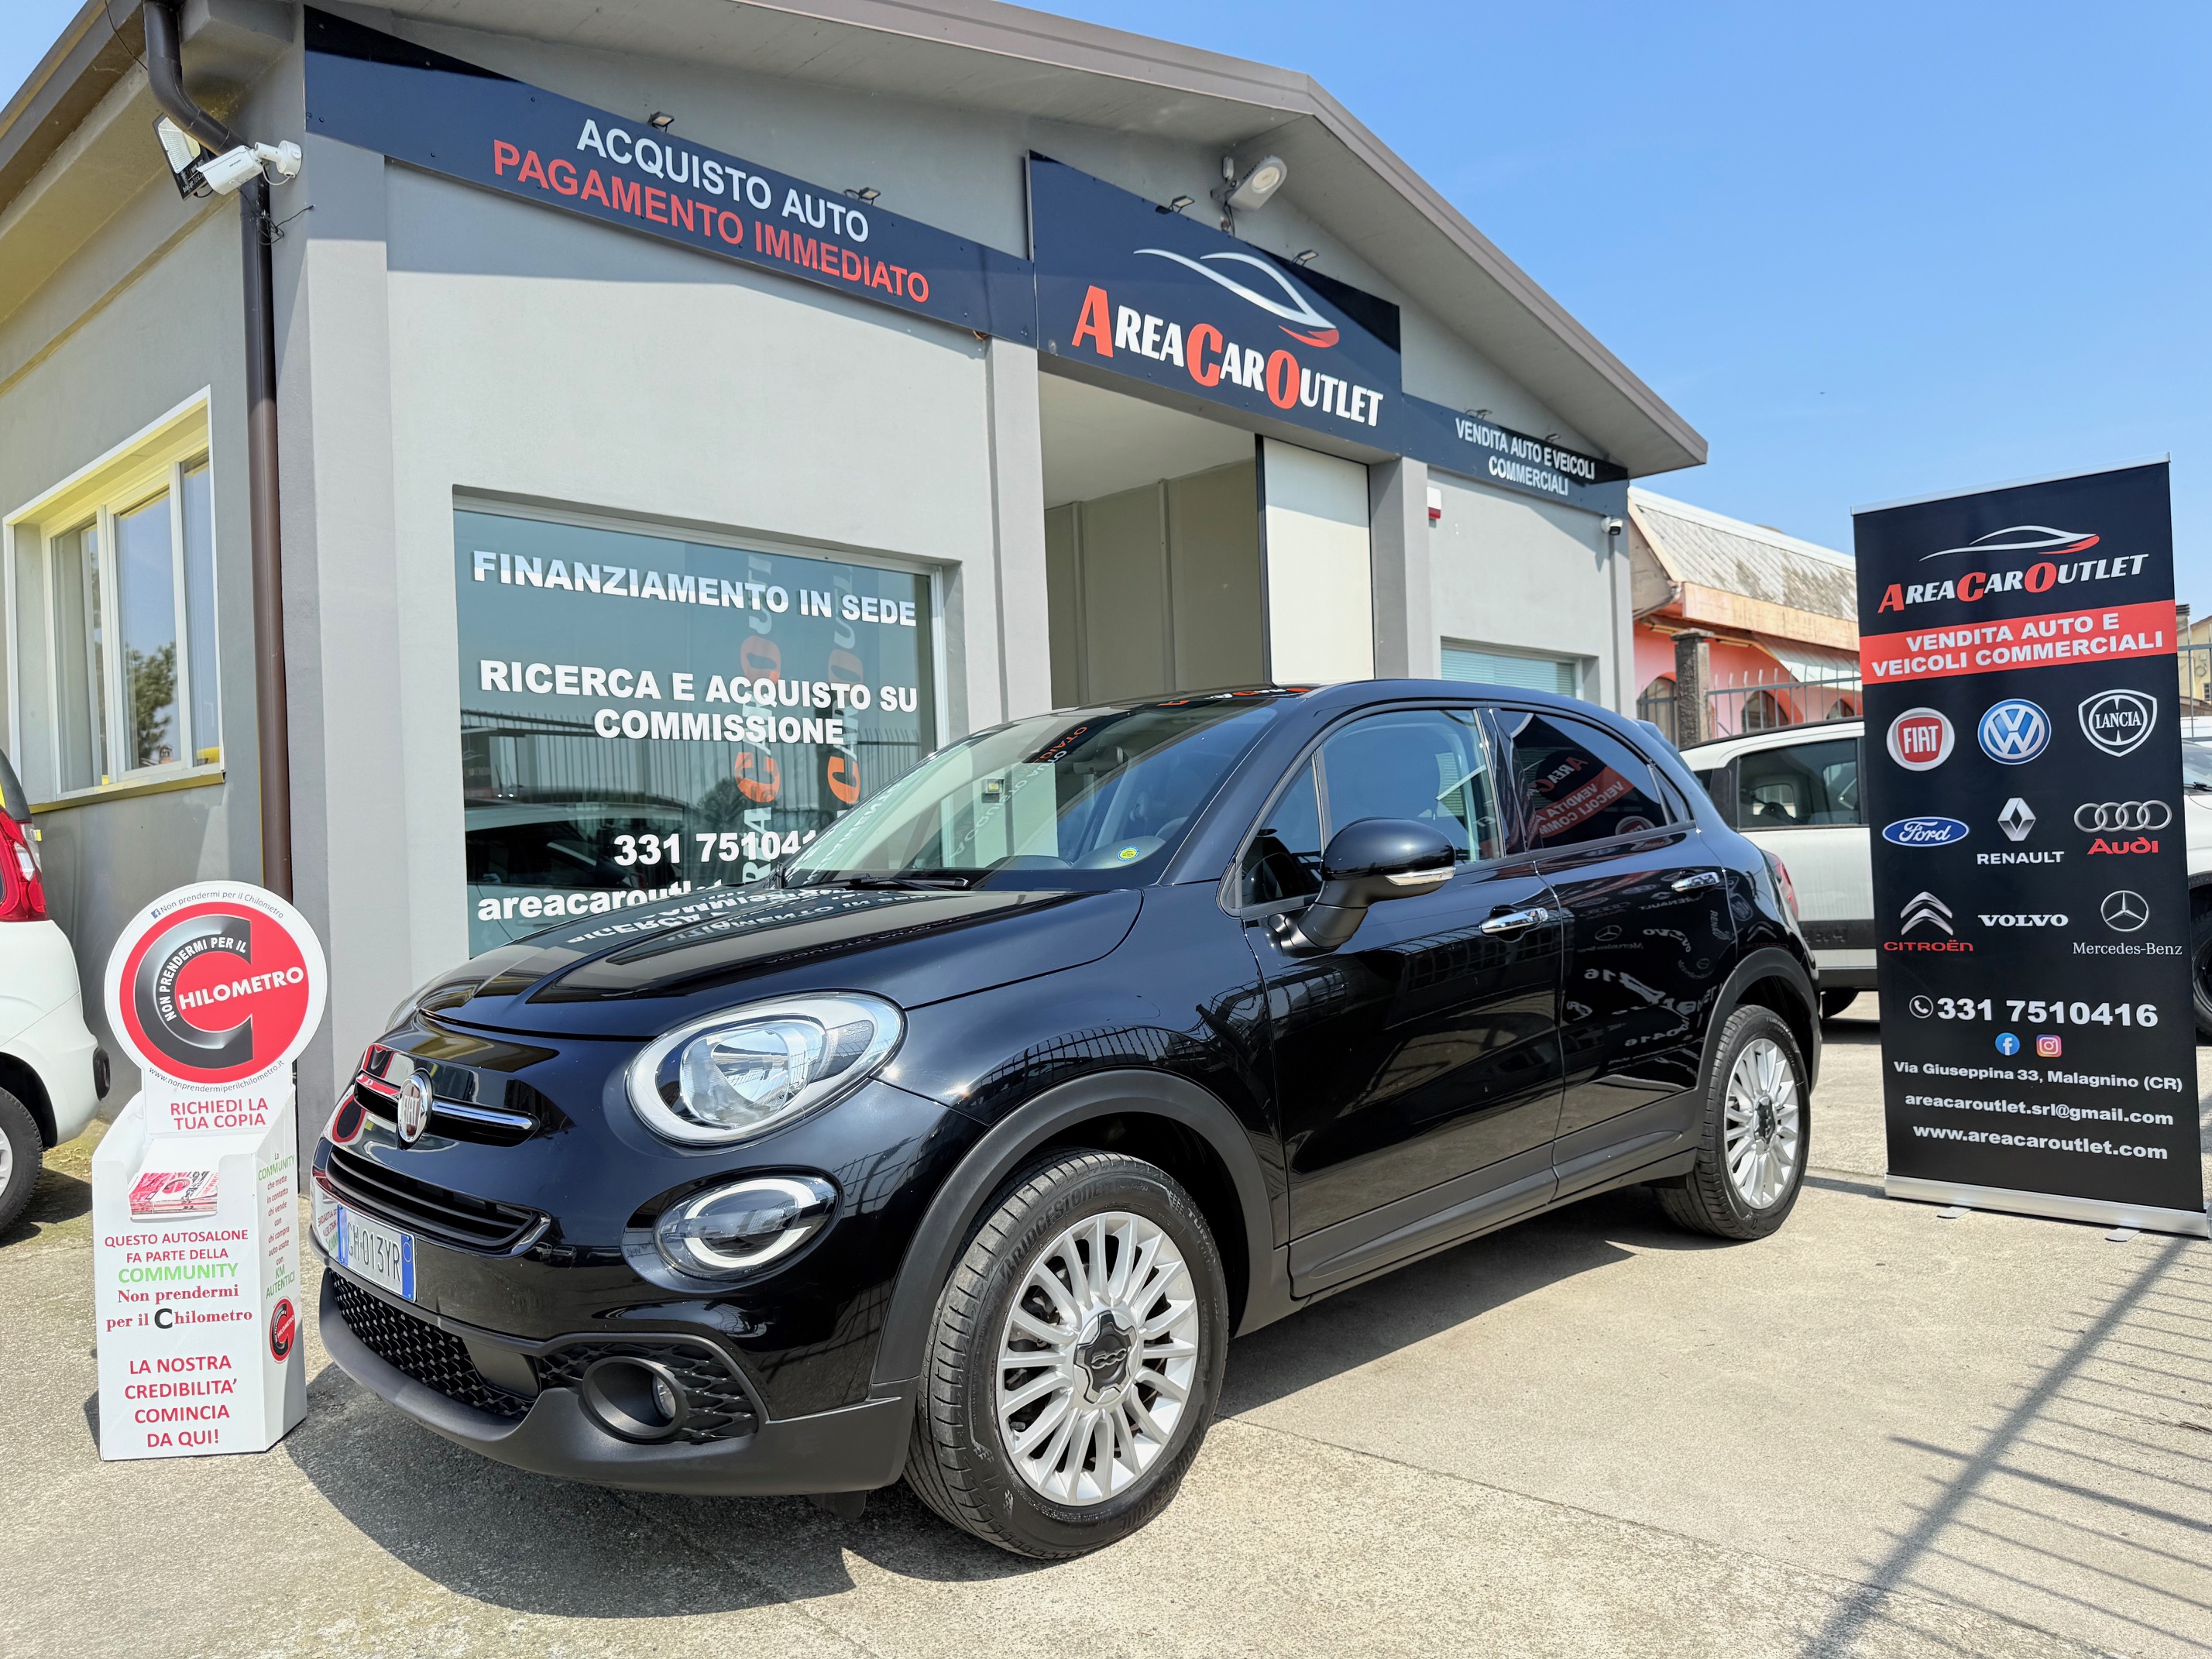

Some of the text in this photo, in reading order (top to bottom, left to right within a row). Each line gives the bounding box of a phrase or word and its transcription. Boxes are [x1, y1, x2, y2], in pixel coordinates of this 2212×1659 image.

[576, 118, 870, 243] ACQUISTO AUTO
[493, 139, 929, 303] PAGAMENTO IMMEDIATO
[1455, 417, 1595, 480] VENDITA AUTO E VEICOLI
[1489, 455, 1568, 496] COMMERCIALI
[472, 550, 916, 627] FINANZIAMENTO IN SEDE
[1906, 613, 2119, 651] VENDITA AUTO E
[1872, 631, 2162, 677] VEICOLI COMMERCIALI
[480, 660, 918, 713] RICERCA E ACQUISTO SU
[594, 709, 844, 745] COMMISSIONE
[2094, 711, 2142, 730] LANCIA
[1903, 724, 1939, 754] FIAT
[1899, 821, 1952, 843] Ford
[614, 830, 816, 866] 331 75104
[1977, 851, 2064, 865] RENAULT
[161, 901, 177, 914] Non
[178, 891, 221, 906] prendermi
[244, 894, 284, 919] Chilometro
[1977, 913, 2069, 928] VOLVO
[1884, 939, 1973, 953] CITROËN
[2073, 942, 2183, 956] Mercedes-Benz
[159, 937, 246, 1022] NON PRENDERMI PER IL
[1936, 998, 2159, 1028] 331 7510416
[149, 1060, 284, 1093] www.nonprendermiperilchilometro.it
[1894, 1061, 2183, 1093] Via Giuseppina 33, Malagnino (CR)
[170, 1097, 269, 1115] RICHIEDI LA
[403, 1094, 419, 1127] FIAT
[1905, 1094, 2173, 1125] areacaroutlet.srl@gmail.com
[173, 1113, 266, 1130] TUA COPIA
[1912, 1125, 2168, 1159] www.areacaroutlet.com
[258, 1154, 295, 1180] COMMUNITY
[272, 1187, 288, 1201] contatto
[274, 1200, 287, 1213] vende
[105, 1229, 249, 1248] QUESTO AUTOSALONE
[275, 1225, 290, 1240] compra
[1000, 1180, 1103, 1283] BRIDGESTONE
[126, 1248, 228, 1263] FA PARTE DELLA
[268, 1239, 290, 1257] auto usate
[118, 1263, 239, 1283] COMMUNITY
[275, 1264, 285, 1279] KM
[118, 1284, 239, 1304] Non prendermi
[266, 1270, 295, 1300] AUTENTICI
[106, 1308, 252, 1332] per il Chilometro
[130, 1355, 232, 1374] LA NOSTRA
[125, 1378, 237, 1399] CREDIBILITA'
[135, 1405, 230, 1424] COMINCIA
[147, 1429, 219, 1448] DA QUI!
